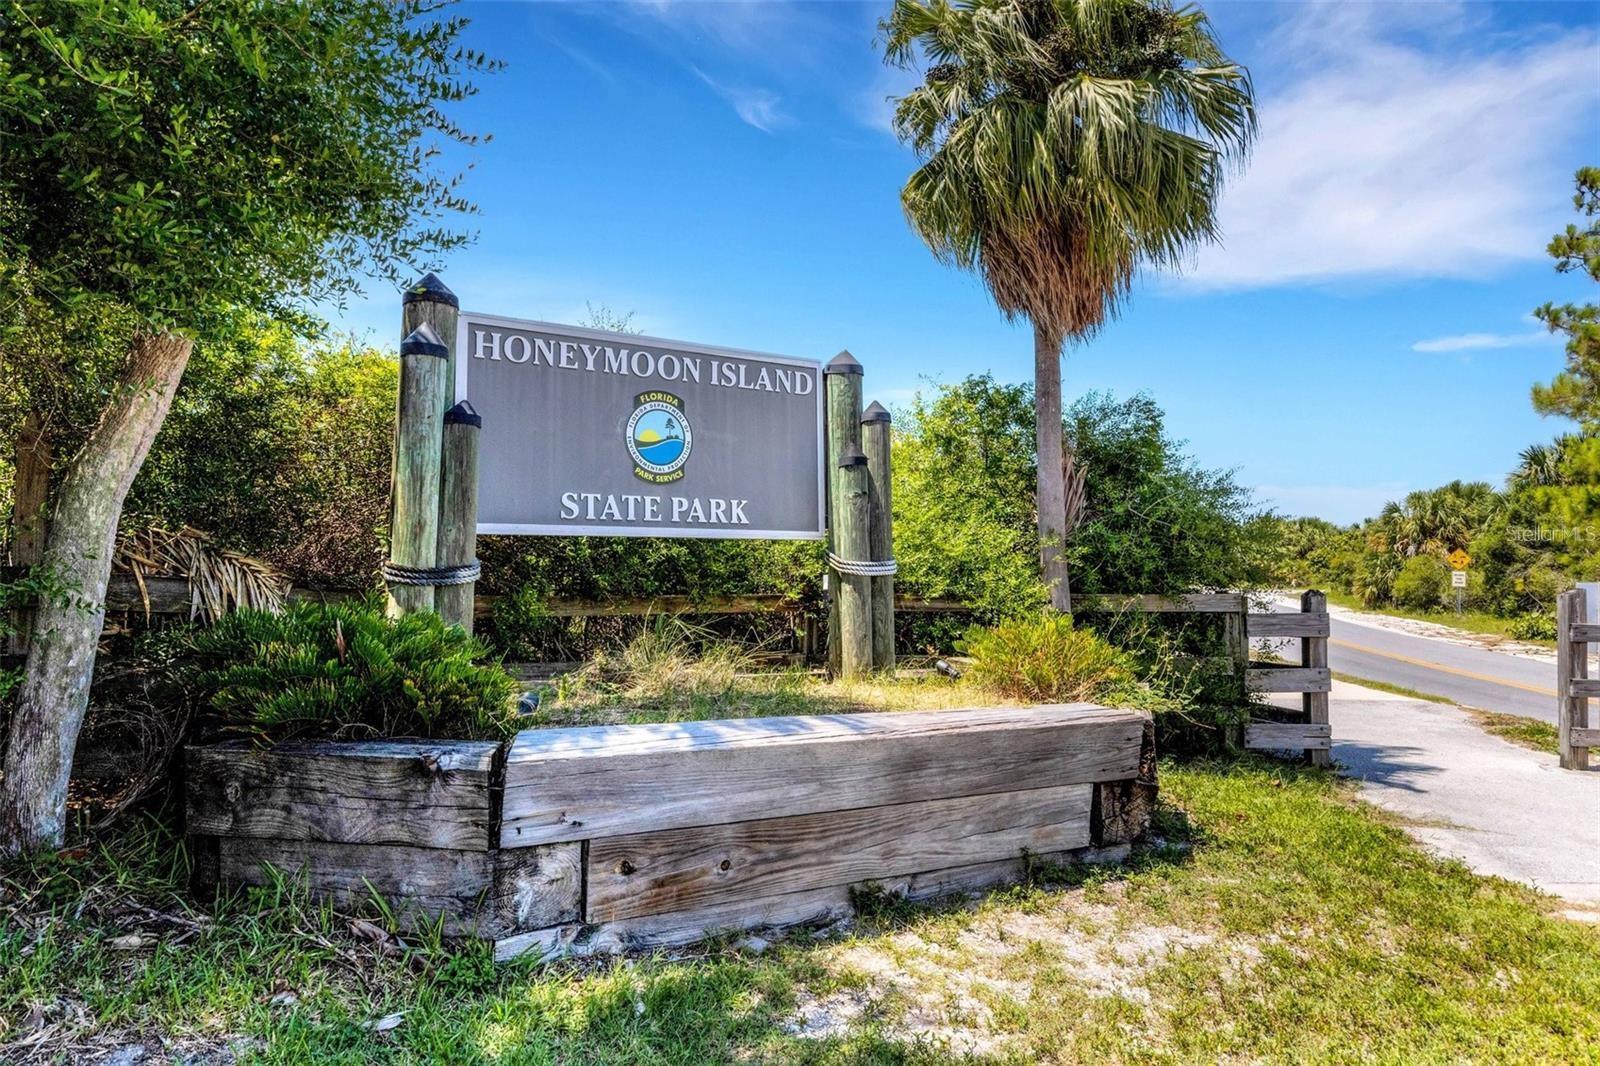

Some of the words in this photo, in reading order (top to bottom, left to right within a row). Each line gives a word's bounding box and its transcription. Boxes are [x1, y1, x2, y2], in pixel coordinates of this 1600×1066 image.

[474, 330, 700, 383] HONEYMOON
[711, 360, 813, 395] ISLAND
[640, 393, 678, 406] FLORIDA
[629, 406, 648, 428] FLORIDA
[650, 403, 685, 423] DEPARTMENT
[683, 424, 690, 433] OF
[627, 436, 666, 472] ENVIRONMENTAL
[667, 440, 691, 471] PROTECTION
[635, 467, 654, 481] PARK
[656, 470, 683, 482] SERVICE
[560, 492, 662, 521] STATE
[671, 497, 750, 524] PARK
